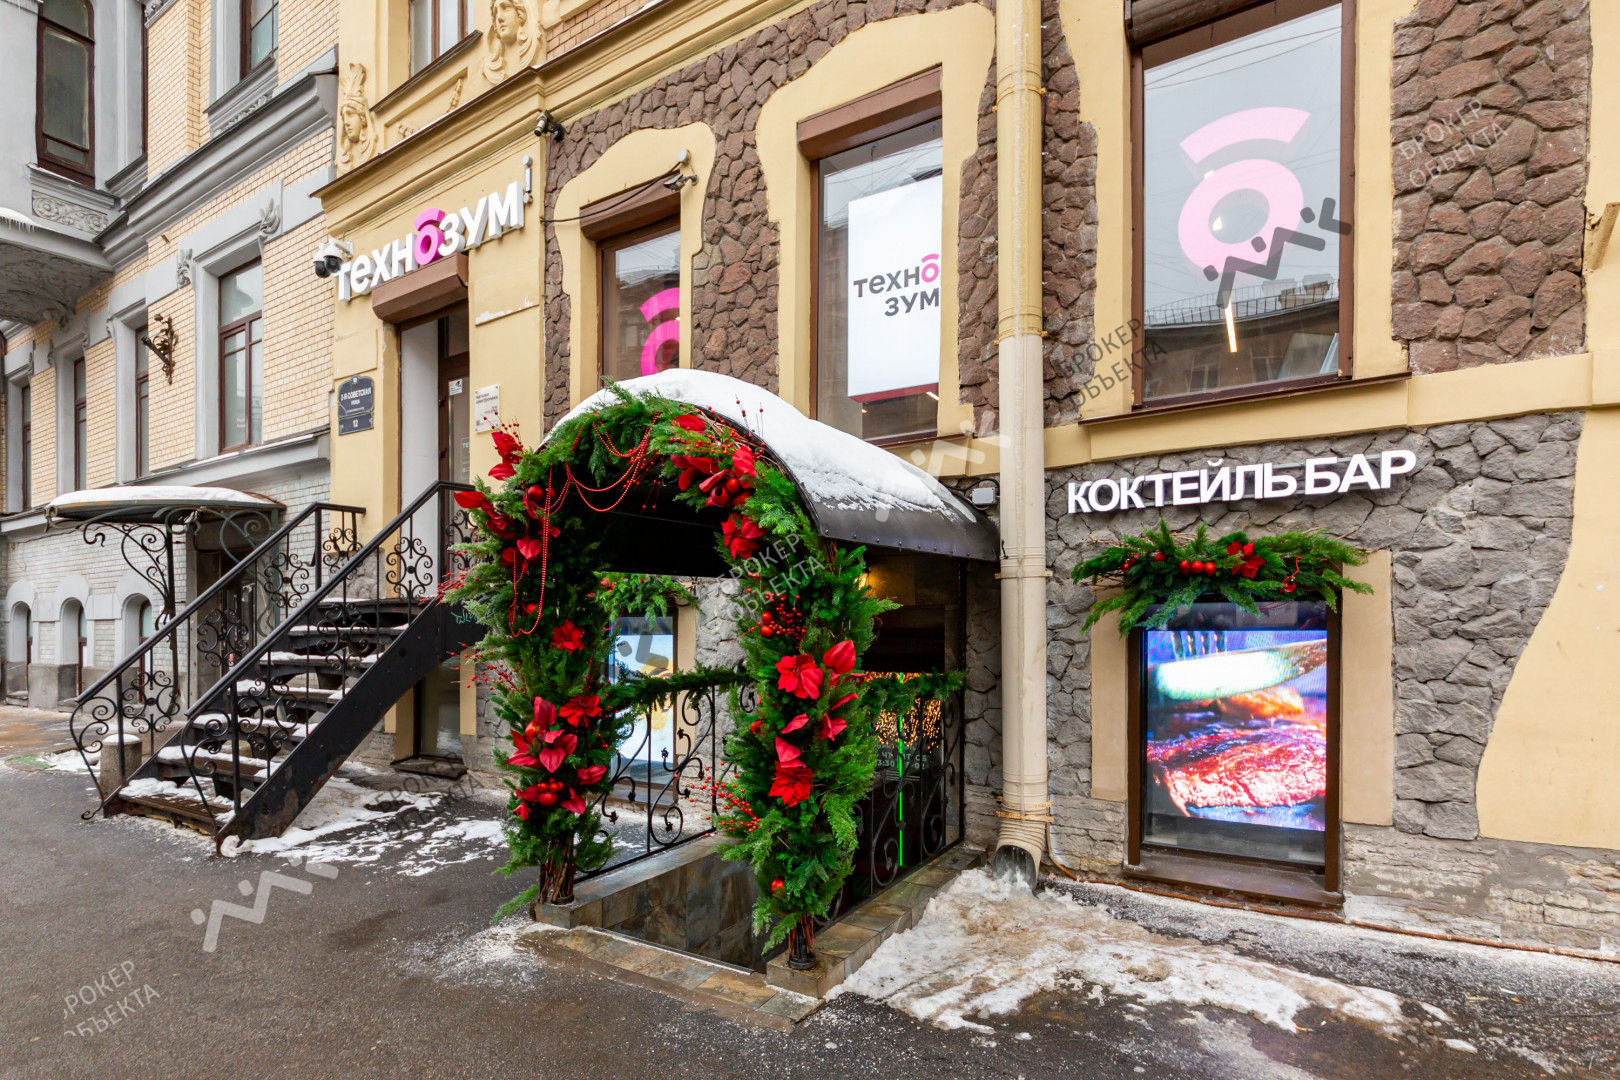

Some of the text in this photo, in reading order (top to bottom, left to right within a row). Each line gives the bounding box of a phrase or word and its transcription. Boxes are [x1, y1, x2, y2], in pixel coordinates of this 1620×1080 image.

[352, 419, 359, 428] 12
[1067, 449, 1417, 514] КОКТЕЙЛЬ БАР
